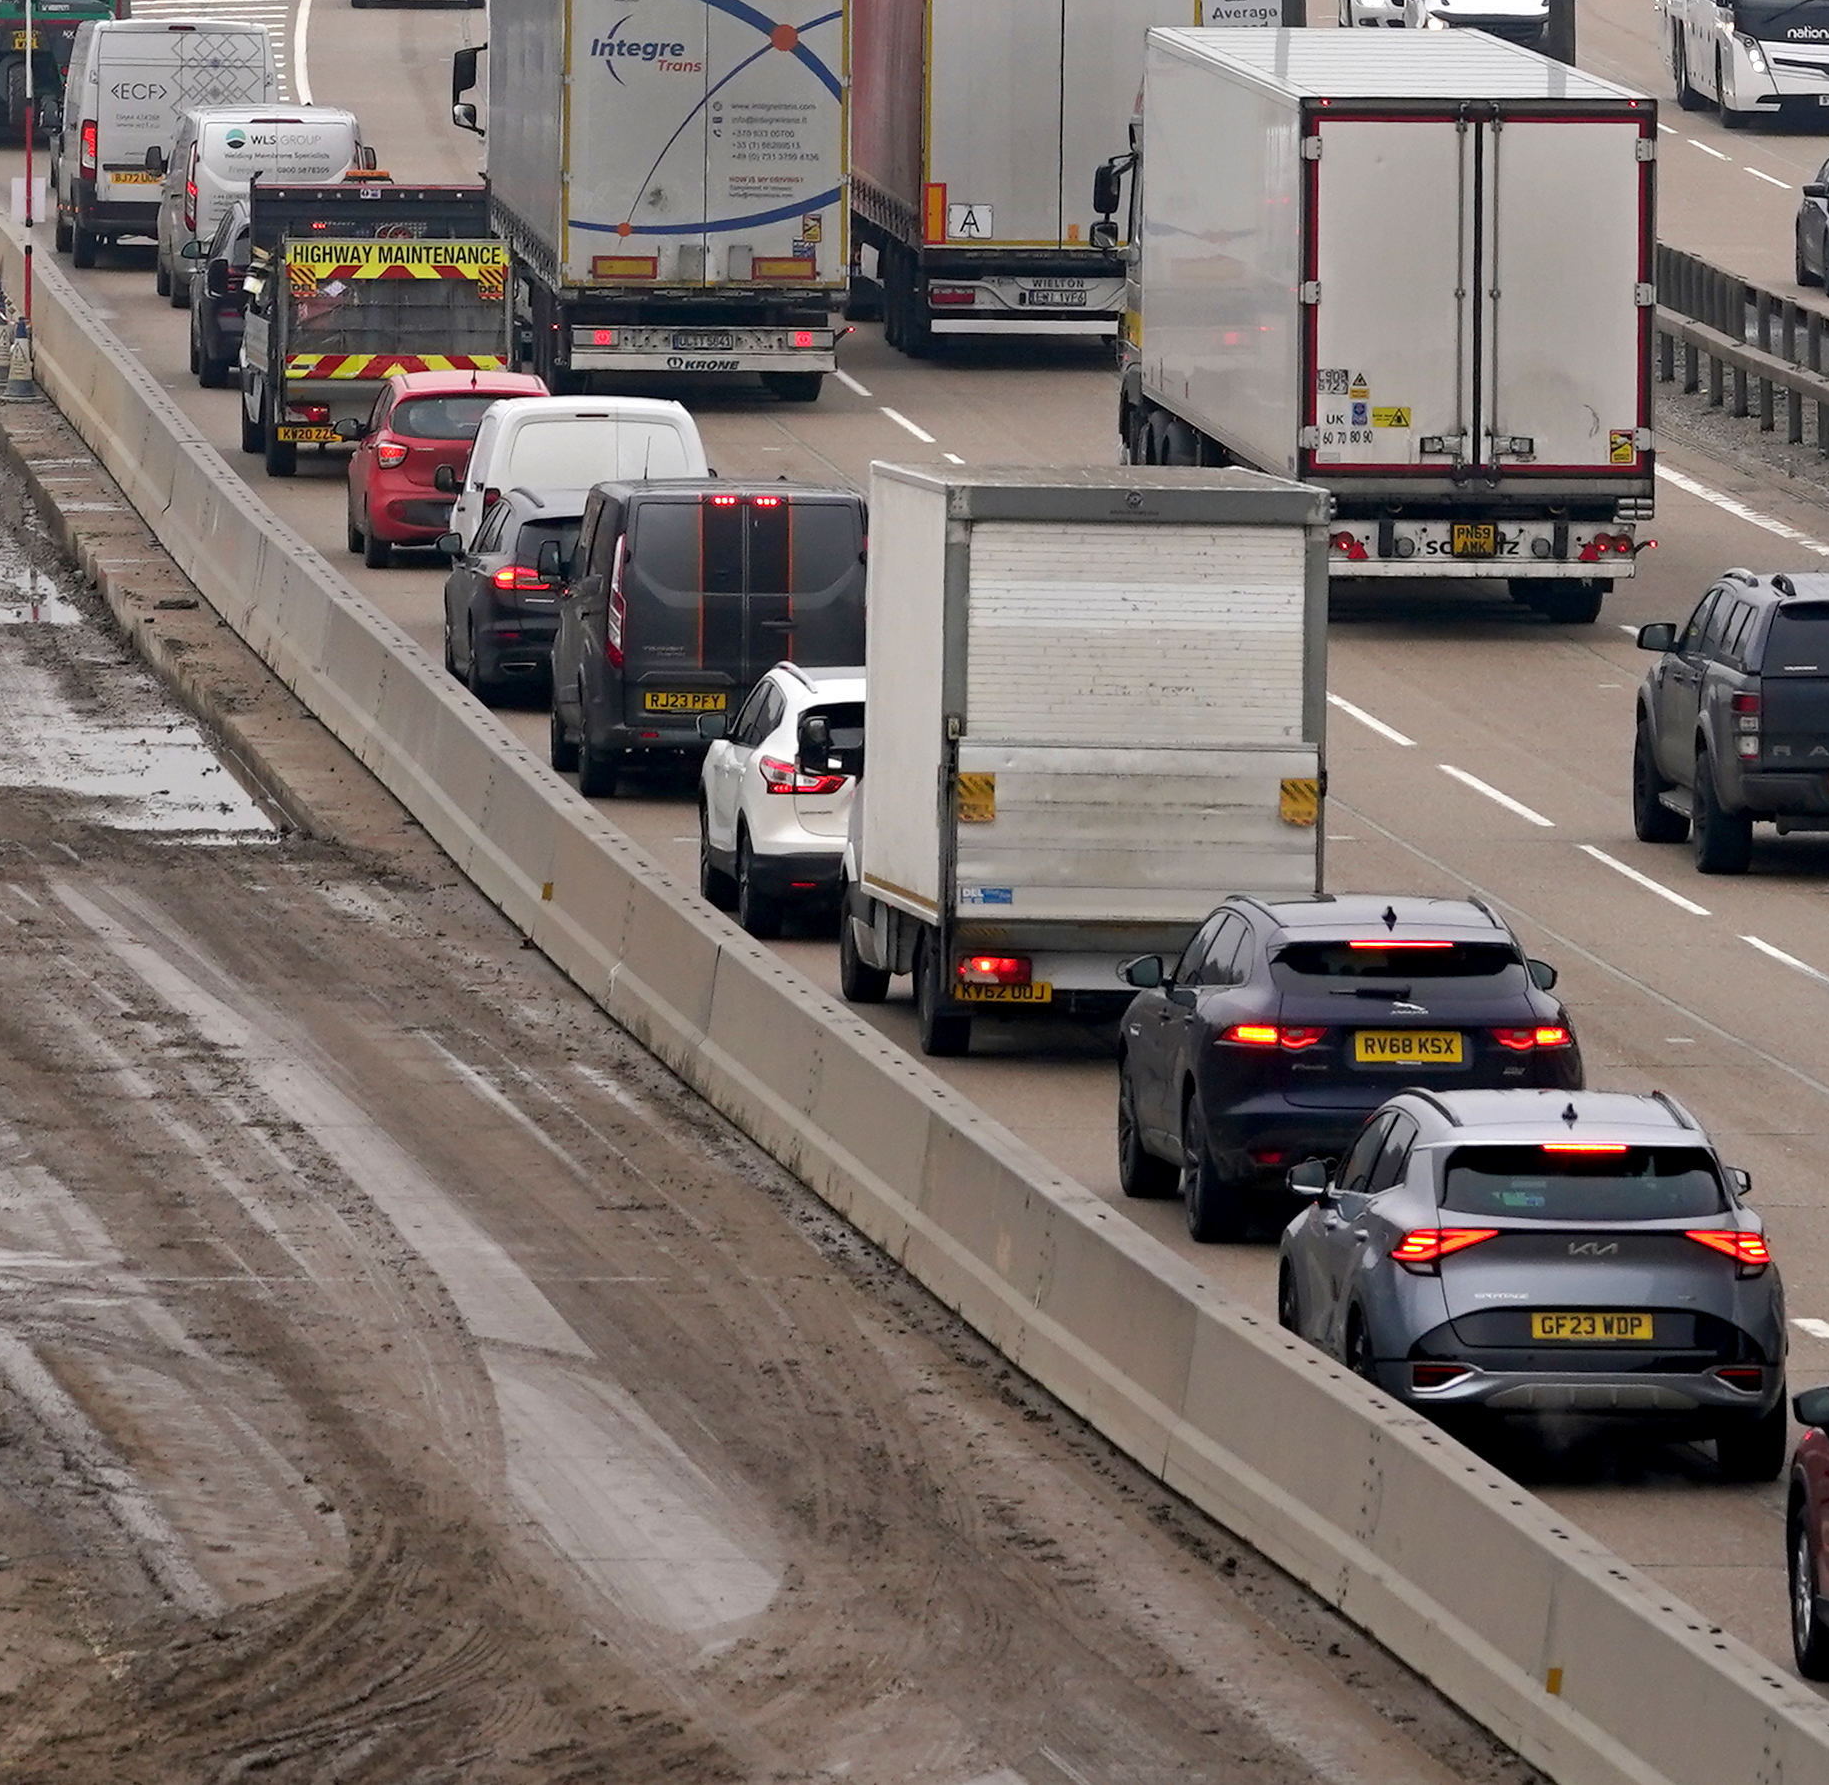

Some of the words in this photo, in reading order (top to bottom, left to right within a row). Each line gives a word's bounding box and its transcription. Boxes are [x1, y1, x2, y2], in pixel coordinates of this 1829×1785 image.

[1213, 8, 1278, 20] Average
[590, 38, 685, 61] Integre
[657, 59, 702, 72] Trans
[250, 135, 276, 145] WLS
[281, 134, 322, 146] GROUP
[224, 152, 252, 160] Welding
[959, 210, 980, 233] A
[293, 246, 373, 264] HIGHWAY
[378, 246, 502, 264] MAINTENANCE
[292, 284, 316, 292] DEL
[479, 285, 503, 294] DEL
[1032, 279, 1084, 288] WIELTON
[685, 360, 740, 370] KRONE
[1326, 414, 1344, 425] UK
[282, 428, 313, 440] KW20
[1322, 432, 1334, 444] 60
[1337, 432, 1347, 444] 70
[1350, 430, 1361, 444] 80
[1363, 430, 1374, 444] 90
[1457, 527, 1490, 540] PN69
[650, 694, 688, 708] RJ23
[962, 888, 984, 898] DEL
[962, 984, 1006, 999] KV62
[1364, 1038, 1413, 1054] RV68
[1418, 1038, 1454, 1054] KSX
[1568, 1242, 1619, 1256] KIA
[1541, 1316, 1596, 1336] GF23
[1604, 1316, 1642, 1335] WDP
